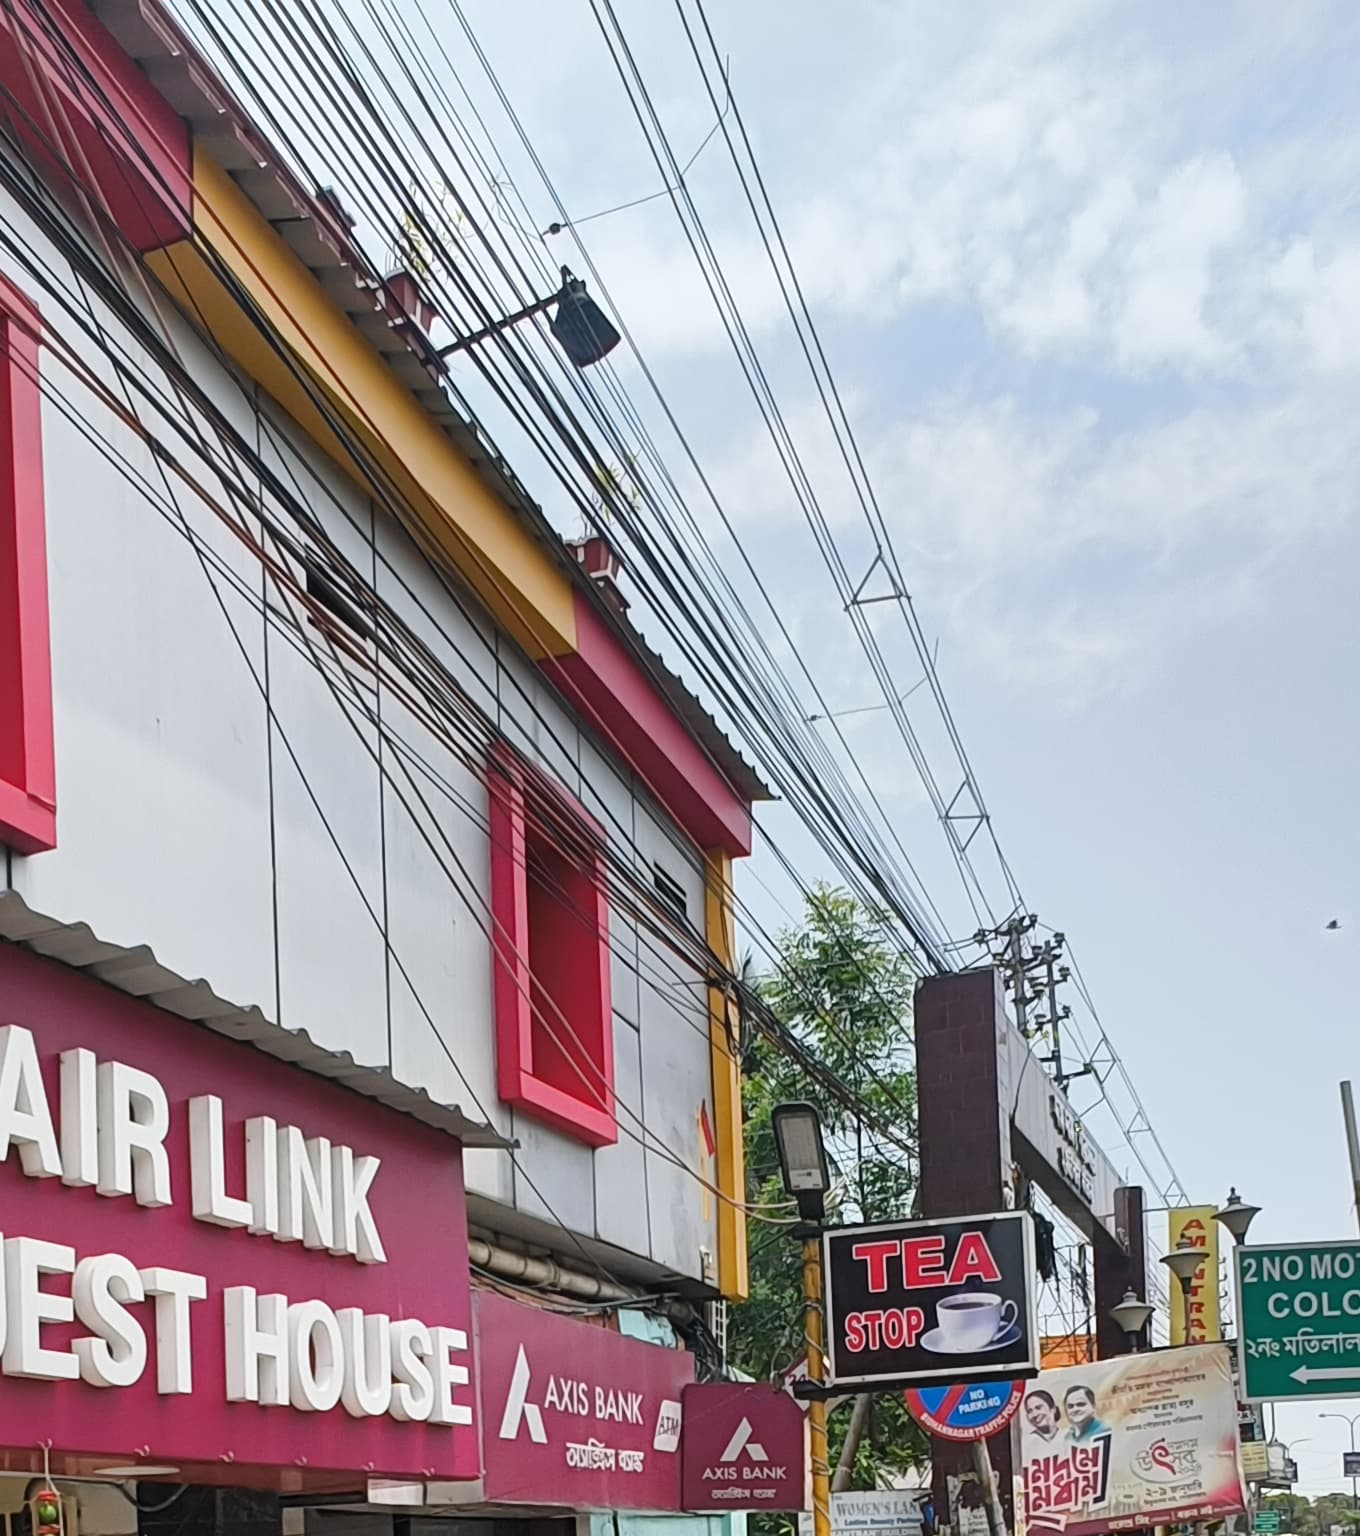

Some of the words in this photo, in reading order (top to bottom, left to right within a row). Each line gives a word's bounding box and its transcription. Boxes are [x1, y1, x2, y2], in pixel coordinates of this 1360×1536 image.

[189, 1094, 387, 1264] LINK
[852, 1231, 1002, 1293] TEA
[1242, 1258, 1258, 1283] 2
[1262, 1255, 1304, 1282] NO
[845, 1306, 924, 1352] STOP
[224, 1286, 472, 1425] HOUSE
[544, 1375, 589, 1416] AXIS
[595, 1386, 644, 1425] BANK
[958, 1396, 1001, 1415] PARKING
[969, 1389, 984, 1401] NO
[658, 1415, 679, 1436] ATM
[975, 1417, 1006, 1437] TRAFFIC
[702, 1467, 737, 1480] AXIS
[743, 1466, 787, 1480] BANK
